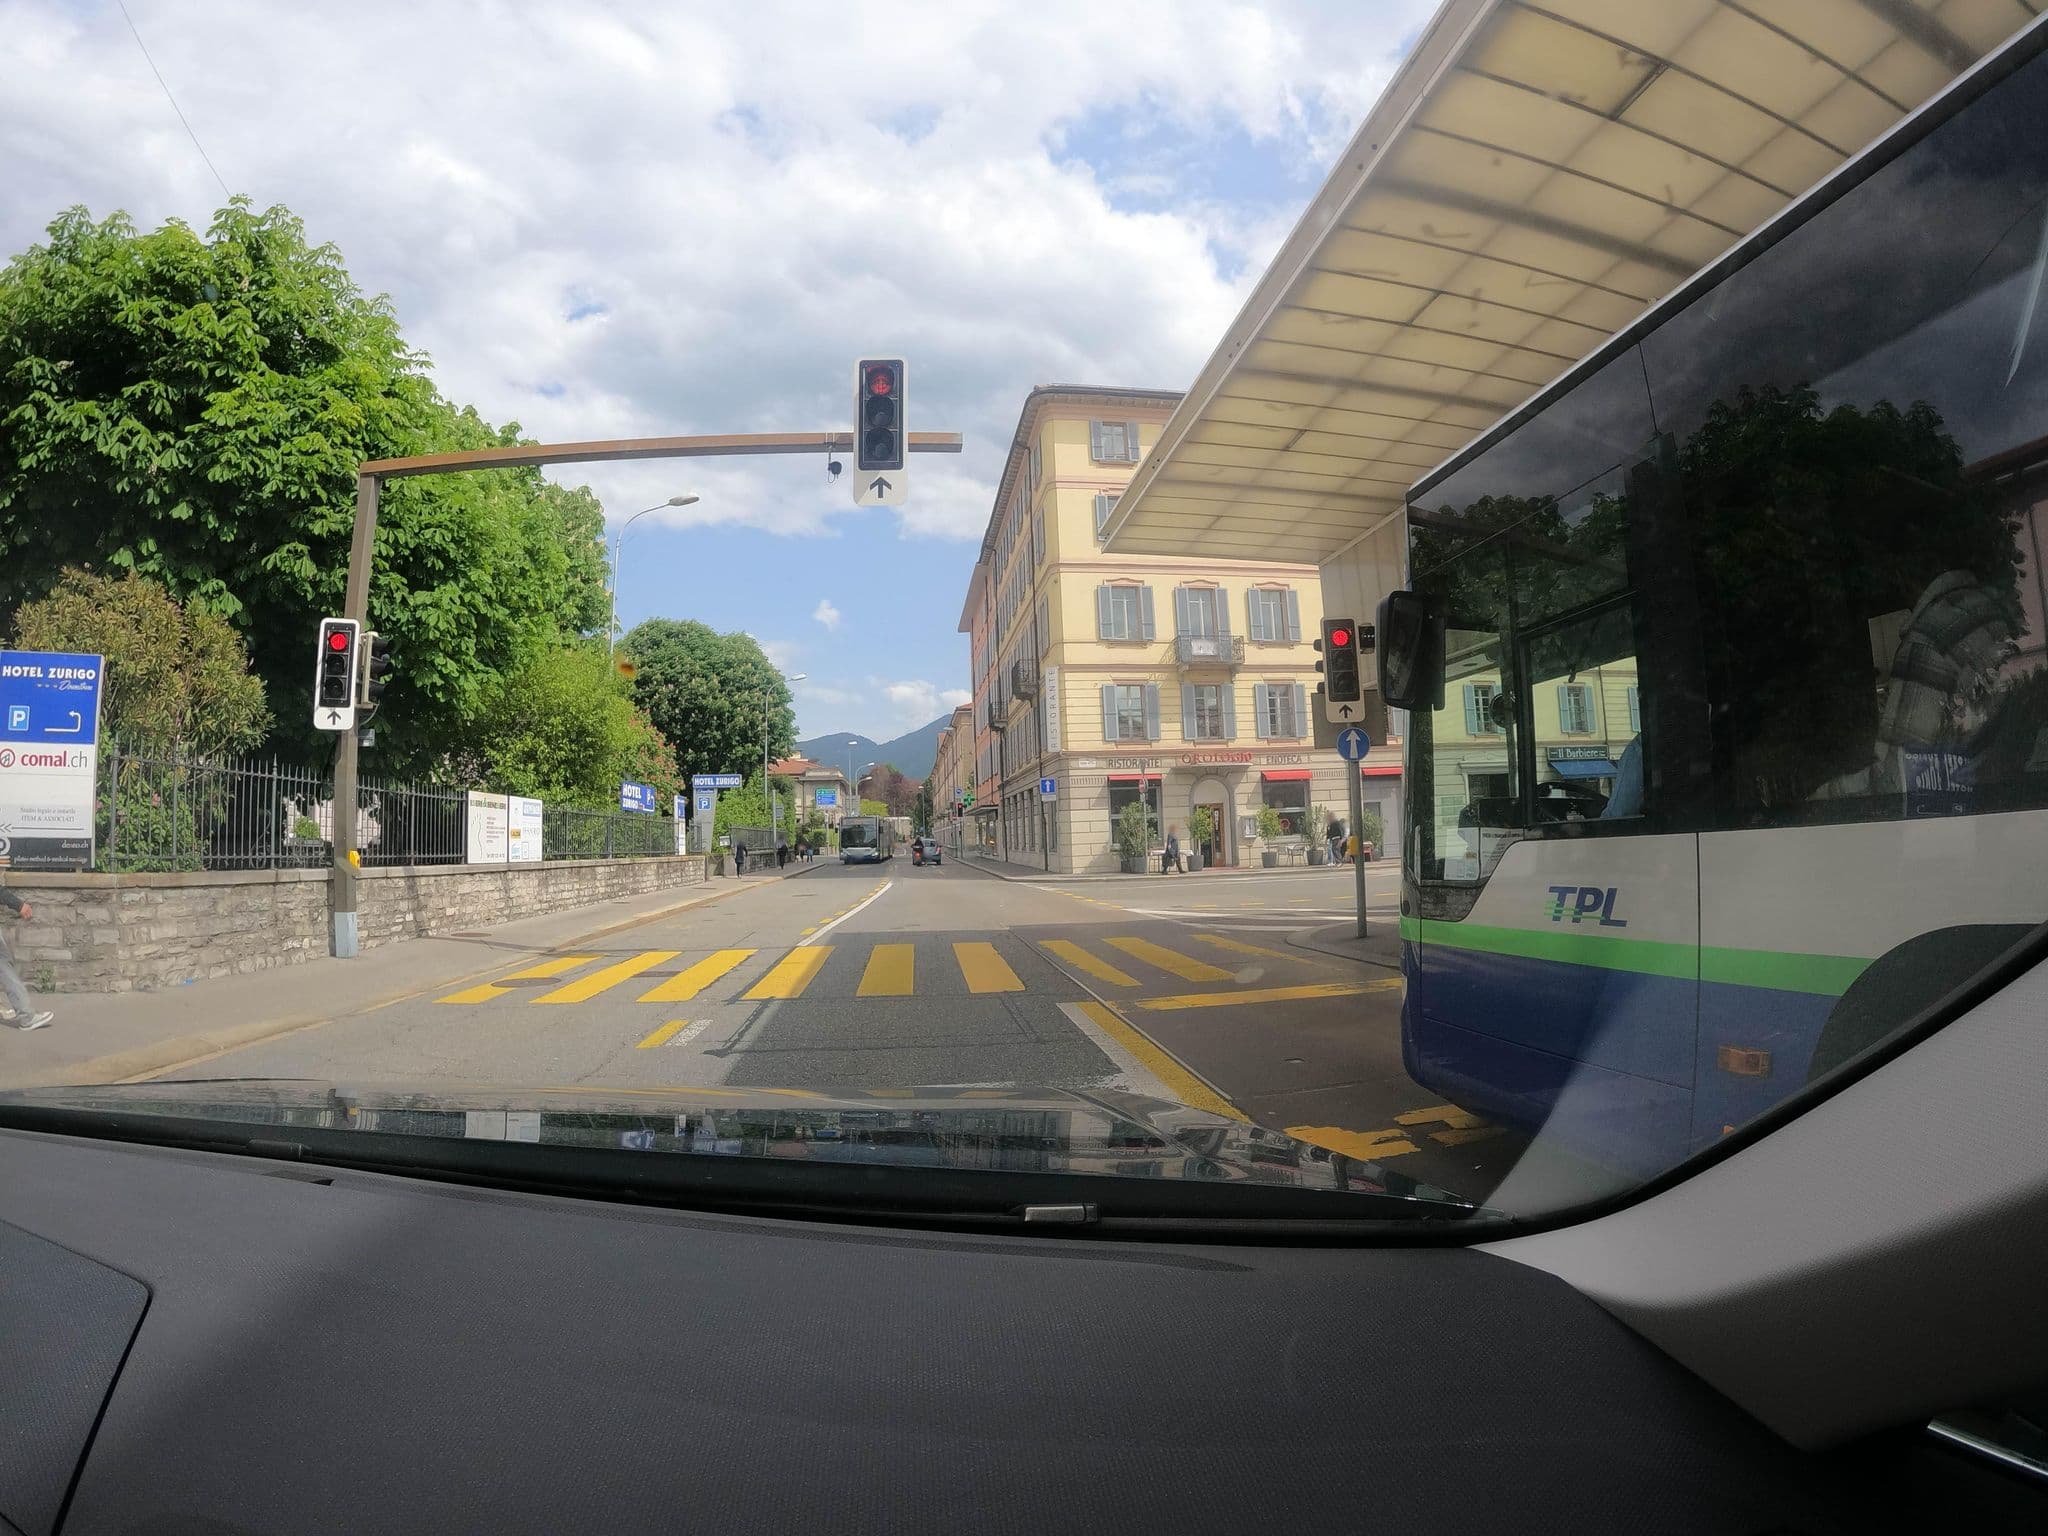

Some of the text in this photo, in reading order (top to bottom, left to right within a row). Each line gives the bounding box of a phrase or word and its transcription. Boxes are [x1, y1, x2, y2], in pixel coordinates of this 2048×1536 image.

[2, 665, 96, 680] HOTEL ZURIGO
[1049, 670, 1058, 749] RISTORANTE
[12, 710, 26, 727] P
[21, 750, 88, 768] comal.ch
[1265, 754, 1302, 765] ENOTECA
[1567, 747, 1599, 759] Barbiere
[1108, 758, 1160, 769] RISTORNTE
[695, 776, 740, 786] HOTEL ZURIGO
[622, 783, 641, 799] HOTEL
[702, 800, 708, 809] P
[1547, 886, 1628, 928] TPL
